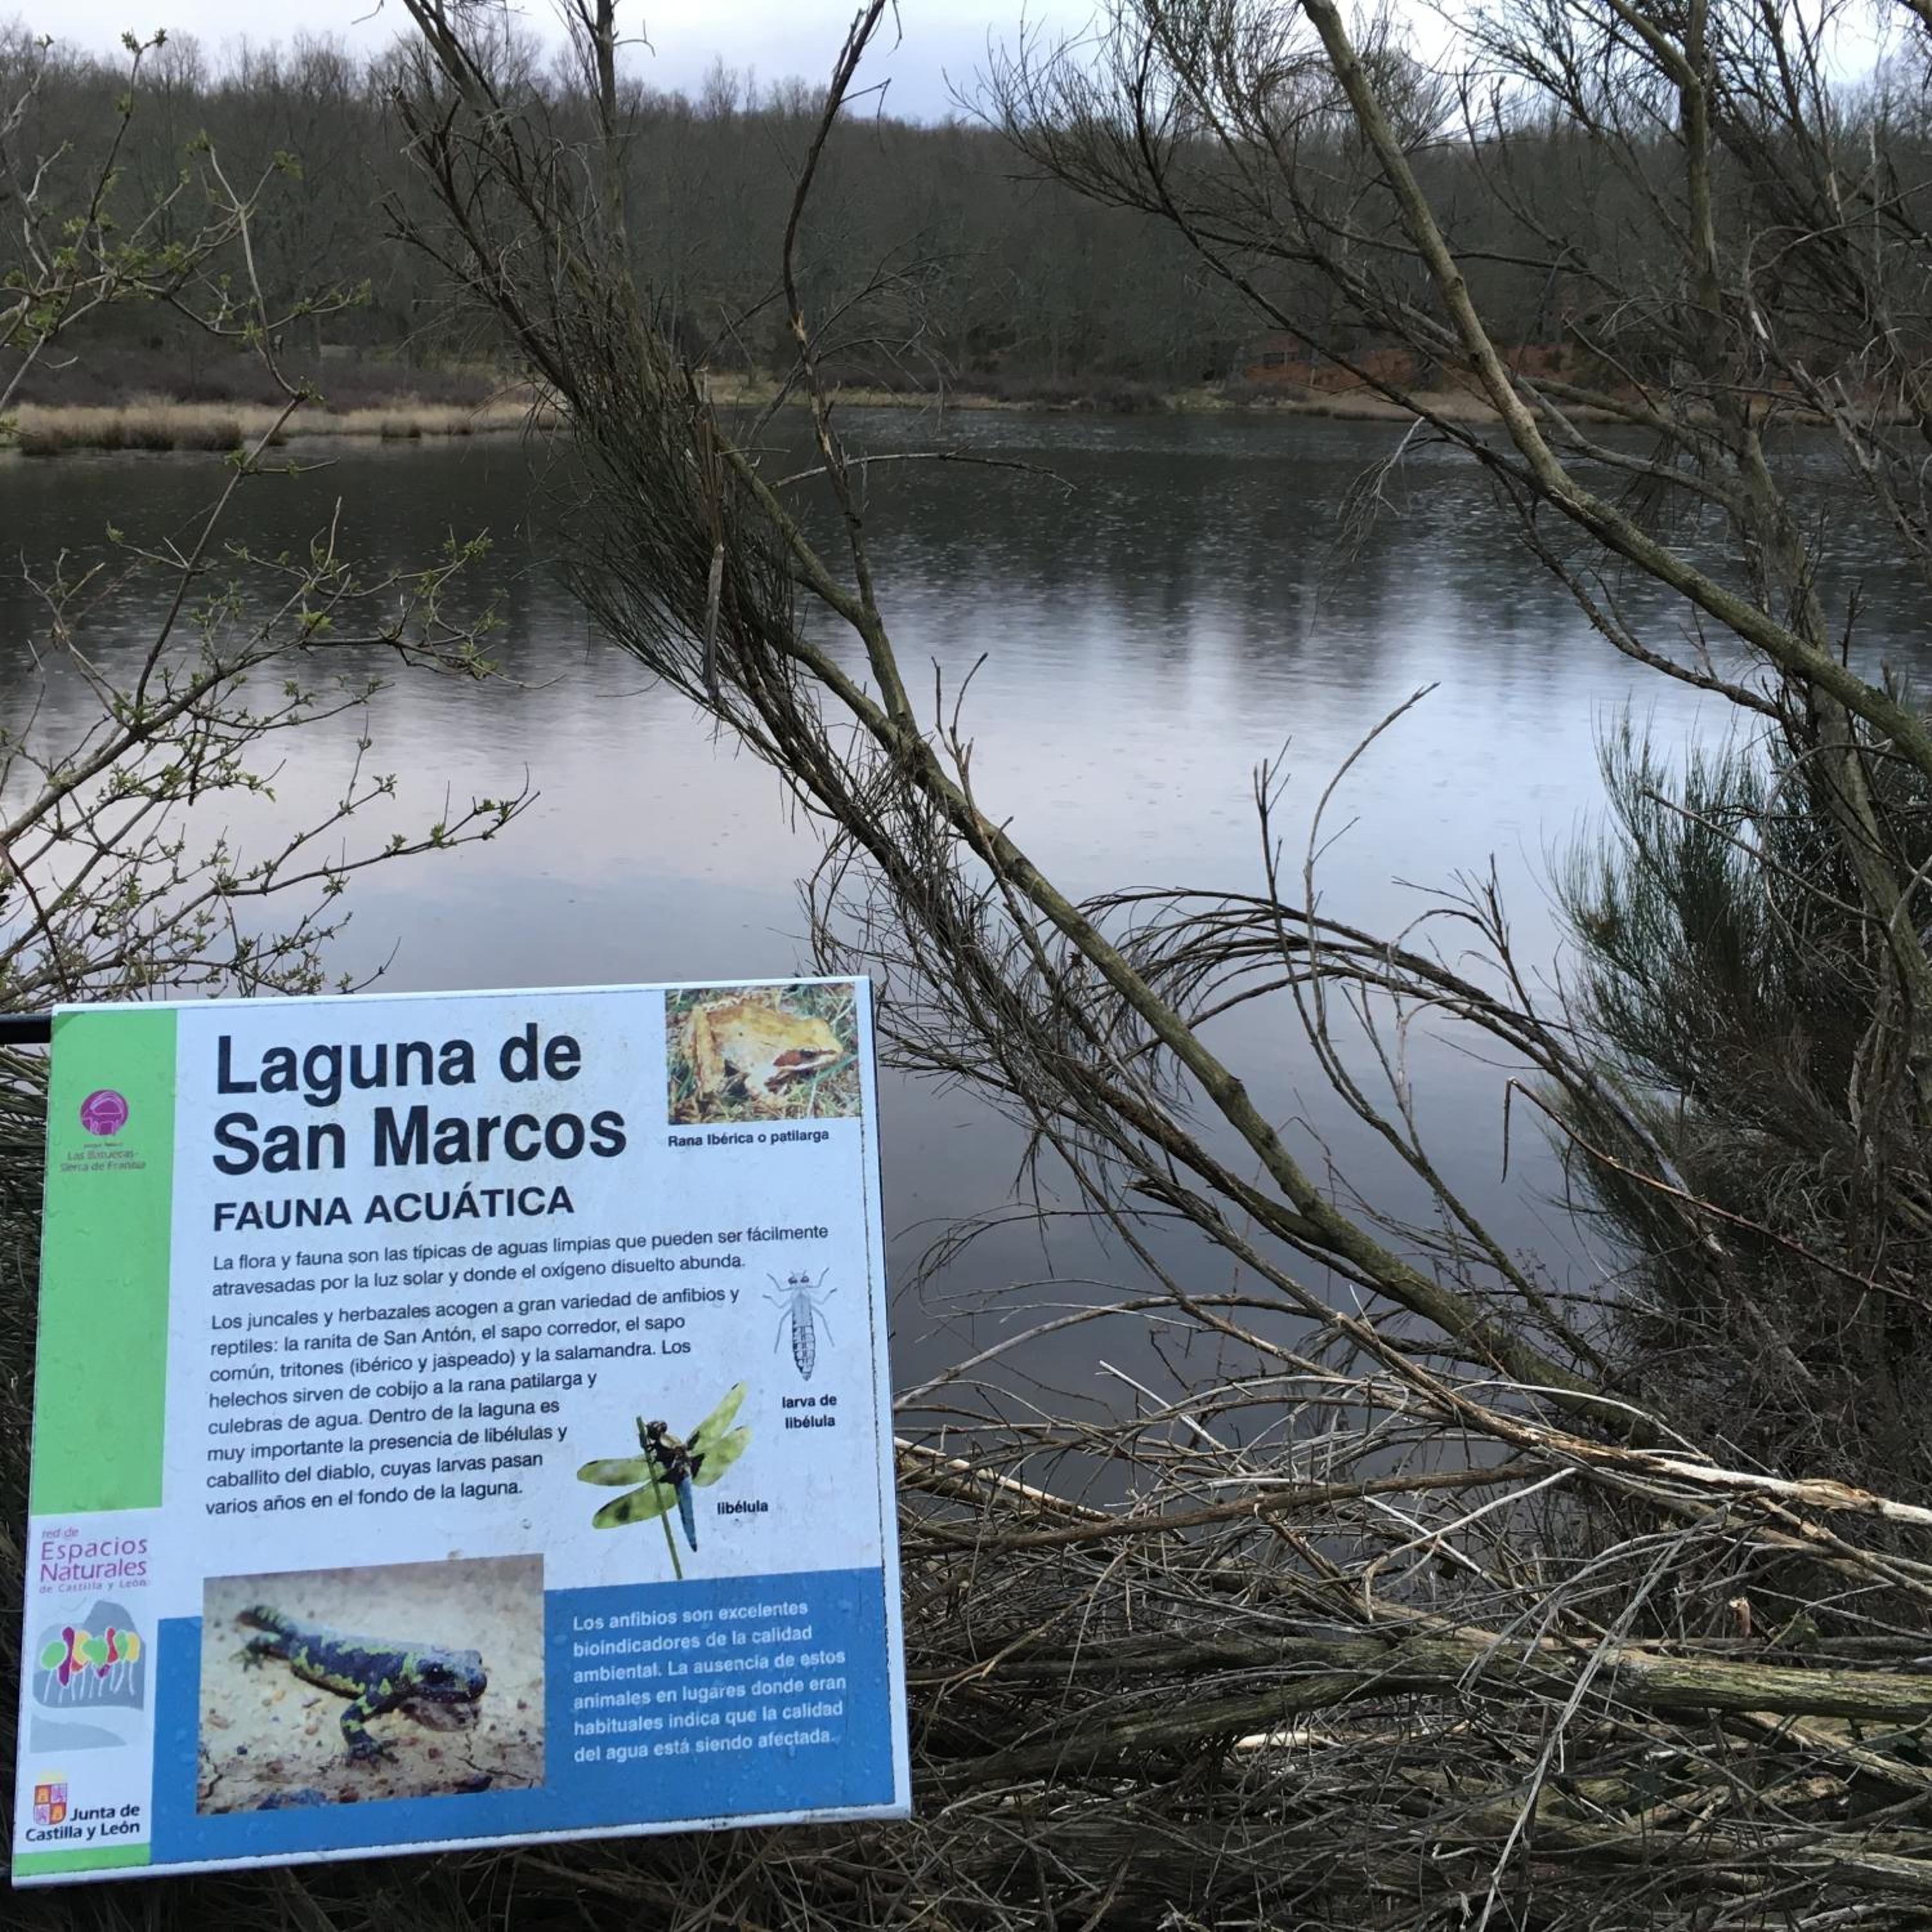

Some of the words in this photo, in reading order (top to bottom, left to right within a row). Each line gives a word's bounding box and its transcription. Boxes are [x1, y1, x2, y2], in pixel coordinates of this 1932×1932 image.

[217, 1034, 477, 1108] Laguna
[498, 1022, 582, 1084] de
[212, 1112, 346, 1176] San
[374, 1104, 627, 1168] Marcos
[667, 1135, 704, 1148] Rana
[706, 1132, 754, 1146] Ibérica
[757, 1133, 767, 1143] o
[770, 1129, 830, 1146] patilarga
[213, 1197, 353, 1233] FAUNA
[363, 1180, 575, 1224] ACUÁTICA
[213, 1255, 234, 1271] La
[238, 1253, 277, 1270] flora
[280, 1255, 292, 1271] y
[294, 1250, 344, 1267] fauna
[348, 1250, 380, 1265] son
[384, 1246, 409, 1262] las
[412, 1244, 468, 1264] típicas
[470, 1241, 493, 1260] de
[497, 1241, 549, 1259] aguas
[553, 1236, 611, 1255] limpias
[614, 1236, 647, 1253] que
[650, 1230, 714, 1251] pueden
[717, 1231, 744, 1244] ser
[745, 1225, 829, 1242] fácilmente
[211, 1277, 316, 1297] atravesadas
[320, 1277, 350, 1294] por
[354, 1273, 370, 1289] la
[374, 1272, 399, 1288] luz
[402, 1269, 445, 1287] solar
[448, 1271, 459, 1287] y
[462, 1265, 518, 1283] donde
[520, 1263, 536, 1280] el
[540, 1260, 607, 1281] oxígeno
[611, 1256, 676, 1274] disuelto
[679, 1253, 746, 1271] abunda.
[211, 1314, 243, 1331] Los
[246, 1309, 319, 1332] juncales
[323, 1311, 334, 1328] y
[338, 1303, 431, 1323] herbazales
[435, 1302, 498, 1320] acogen
[502, 1301, 515, 1314] a
[516, 1298, 556, 1316] gran
[560, 1291, 632, 1310] variedad
[636, 1290, 658, 1306] de
[661, 1286, 726, 1305] anfibios
[729, 1289, 741, 1304] y
[210, 1338, 279, 1359] reptiles:
[283, 1336, 299, 1352] la
[303, 1333, 352, 1350] ranita
[356, 1331, 379, 1348] de
[383, 1329, 417, 1347] San
[421, 1325, 477, 1344] Antón,
[480, 1323, 497, 1340] el
[500, 1324, 543, 1343] sapo
[546, 1318, 621, 1337] corredor,
[625, 1315, 640, 1332] el
[644, 1316, 686, 1334] sapo
[209, 1363, 275, 1383] común,
[279, 1361, 345, 1378] tritones
[349, 1355, 413, 1378] (ibérico
[417, 1356, 428, 1374] y
[431, 1348, 516, 1373] jaspeado)
[520, 1350, 531, 1368] y
[535, 1346, 551, 1363] la
[553, 1341, 656, 1361] salamandra.
[661, 1339, 692, 1356] Los
[209, 1390, 289, 1409] helechos
[292, 1387, 344, 1404] sirven
[348, 1383, 372, 1400] de
[375, 1379, 429, 1401] cobijo
[432, 1381, 444, 1395] a
[448, 1378, 464, 1394] la
[468, 1378, 508, 1392] rana
[509, 1372, 583, 1394] patilarga
[587, 1372, 598, 1389] y
[781, 1396, 817, 1409] larva
[819, 1393, 838, 1407] de
[207, 1417, 283, 1435] culebras
[287, 1414, 310, 1430] de
[314, 1413, 363, 1432] agua.
[368, 1407, 428, 1426] Dentro
[430, 1403, 454, 1421] de
[458, 1403, 475, 1419] la
[477, 1401, 536, 1421] laguna
[539, 1400, 560, 1414] es
[784, 1414, 836, 1430] libélula
[207, 1447, 246, 1464] muy
[251, 1439, 345, 1461] importante
[348, 1435, 365, 1452] la
[368, 1430, 453, 1455] presencia
[456, 1428, 480, 1446] de
[484, 1424, 554, 1444] libélulas
[556, 1426, 568, 1443] y
[205, 1469, 281, 1489] caballito
[284, 1465, 312, 1484] del
[316, 1463, 375, 1482] diablo,
[380, 1461, 432, 1480] cuyas
[436, 1456, 487, 1473] larvas
[491, 1453, 544, 1473] pasan
[205, 1497, 258, 1515] varios
[262, 1494, 307, 1512] años
[310, 1494, 333, 1509] en
[337, 1489, 354, 1507] el
[355, 1486, 409, 1505] fondo
[413, 1484, 437, 1502] de
[440, 1483, 457, 1500] la
[460, 1481, 524, 1501] laguna.
[717, 1499, 769, 1515] libélula
[41, 1537, 147, 1564] Espacios
[41, 1558, 147, 1582] Naturales
[573, 1616, 605, 1631] Los
[609, 1609, 677, 1629] anfibios
[682, 1609, 714, 1623] son
[718, 1601, 809, 1621] excelentes
[573, 1635, 701, 1658] bioindicadores
[705, 1631, 727, 1647] de
[732, 1630, 746, 1645] la
[752, 1624, 813, 1644] calidad
[573, 1662, 662, 1684] ambiental.
[668, 1660, 688, 1676] La
[693, 1656, 770, 1674] ausencia
[773, 1652, 795, 1669] de
[800, 1649, 846, 1669] estos
[573, 1689, 652, 1711] animales
[656, 1689, 677, 1703] en
[682, 1684, 746, 1704] lugares
[751, 1677, 804, 1696] donde
[809, 1676, 847, 1692] eran
[574, 1715, 664, 1736] habituales
[668, 1710, 721, 1728] indica
[724, 1709, 757, 1727] que
[762, 1705, 778, 1721] la
[782, 1700, 844, 1720] calidad
[574, 1745, 601, 1763] del
[605, 1744, 649, 1763] agua
[653, 1737, 690, 1757] está
[695, 1734, 753, 1753] siendo
[758, 1729, 835, 1747] afectada.
[70, 1806, 116, 1822] Junta
[120, 1804, 141, 1817] de
[25, 1826, 83, 1842] Castilla
[86, 1826, 97, 1841] y
[100, 1821, 140, 1836] León
